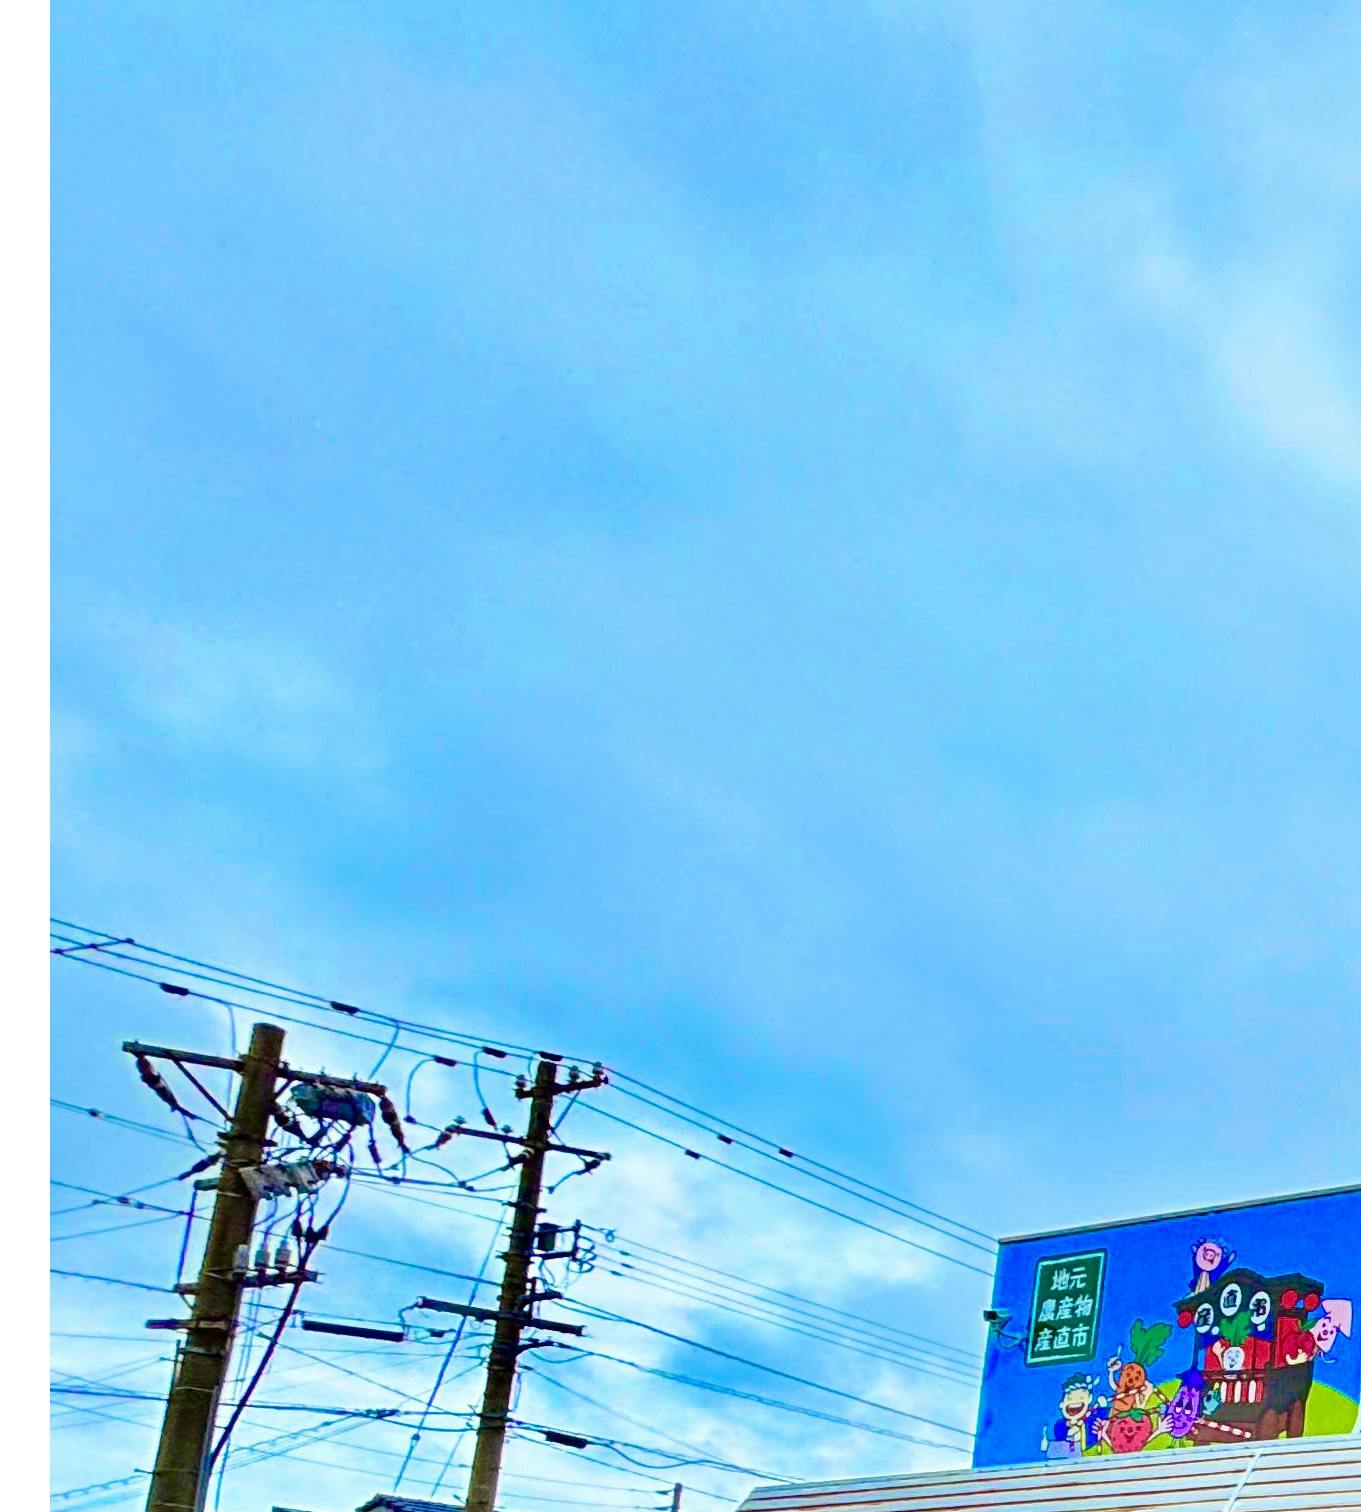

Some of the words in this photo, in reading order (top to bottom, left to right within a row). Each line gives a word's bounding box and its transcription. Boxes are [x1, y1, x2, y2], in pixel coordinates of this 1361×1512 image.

[1050, 1266, 1088, 1291] 地元
[1034, 1323, 1090, 1352] 産直市
